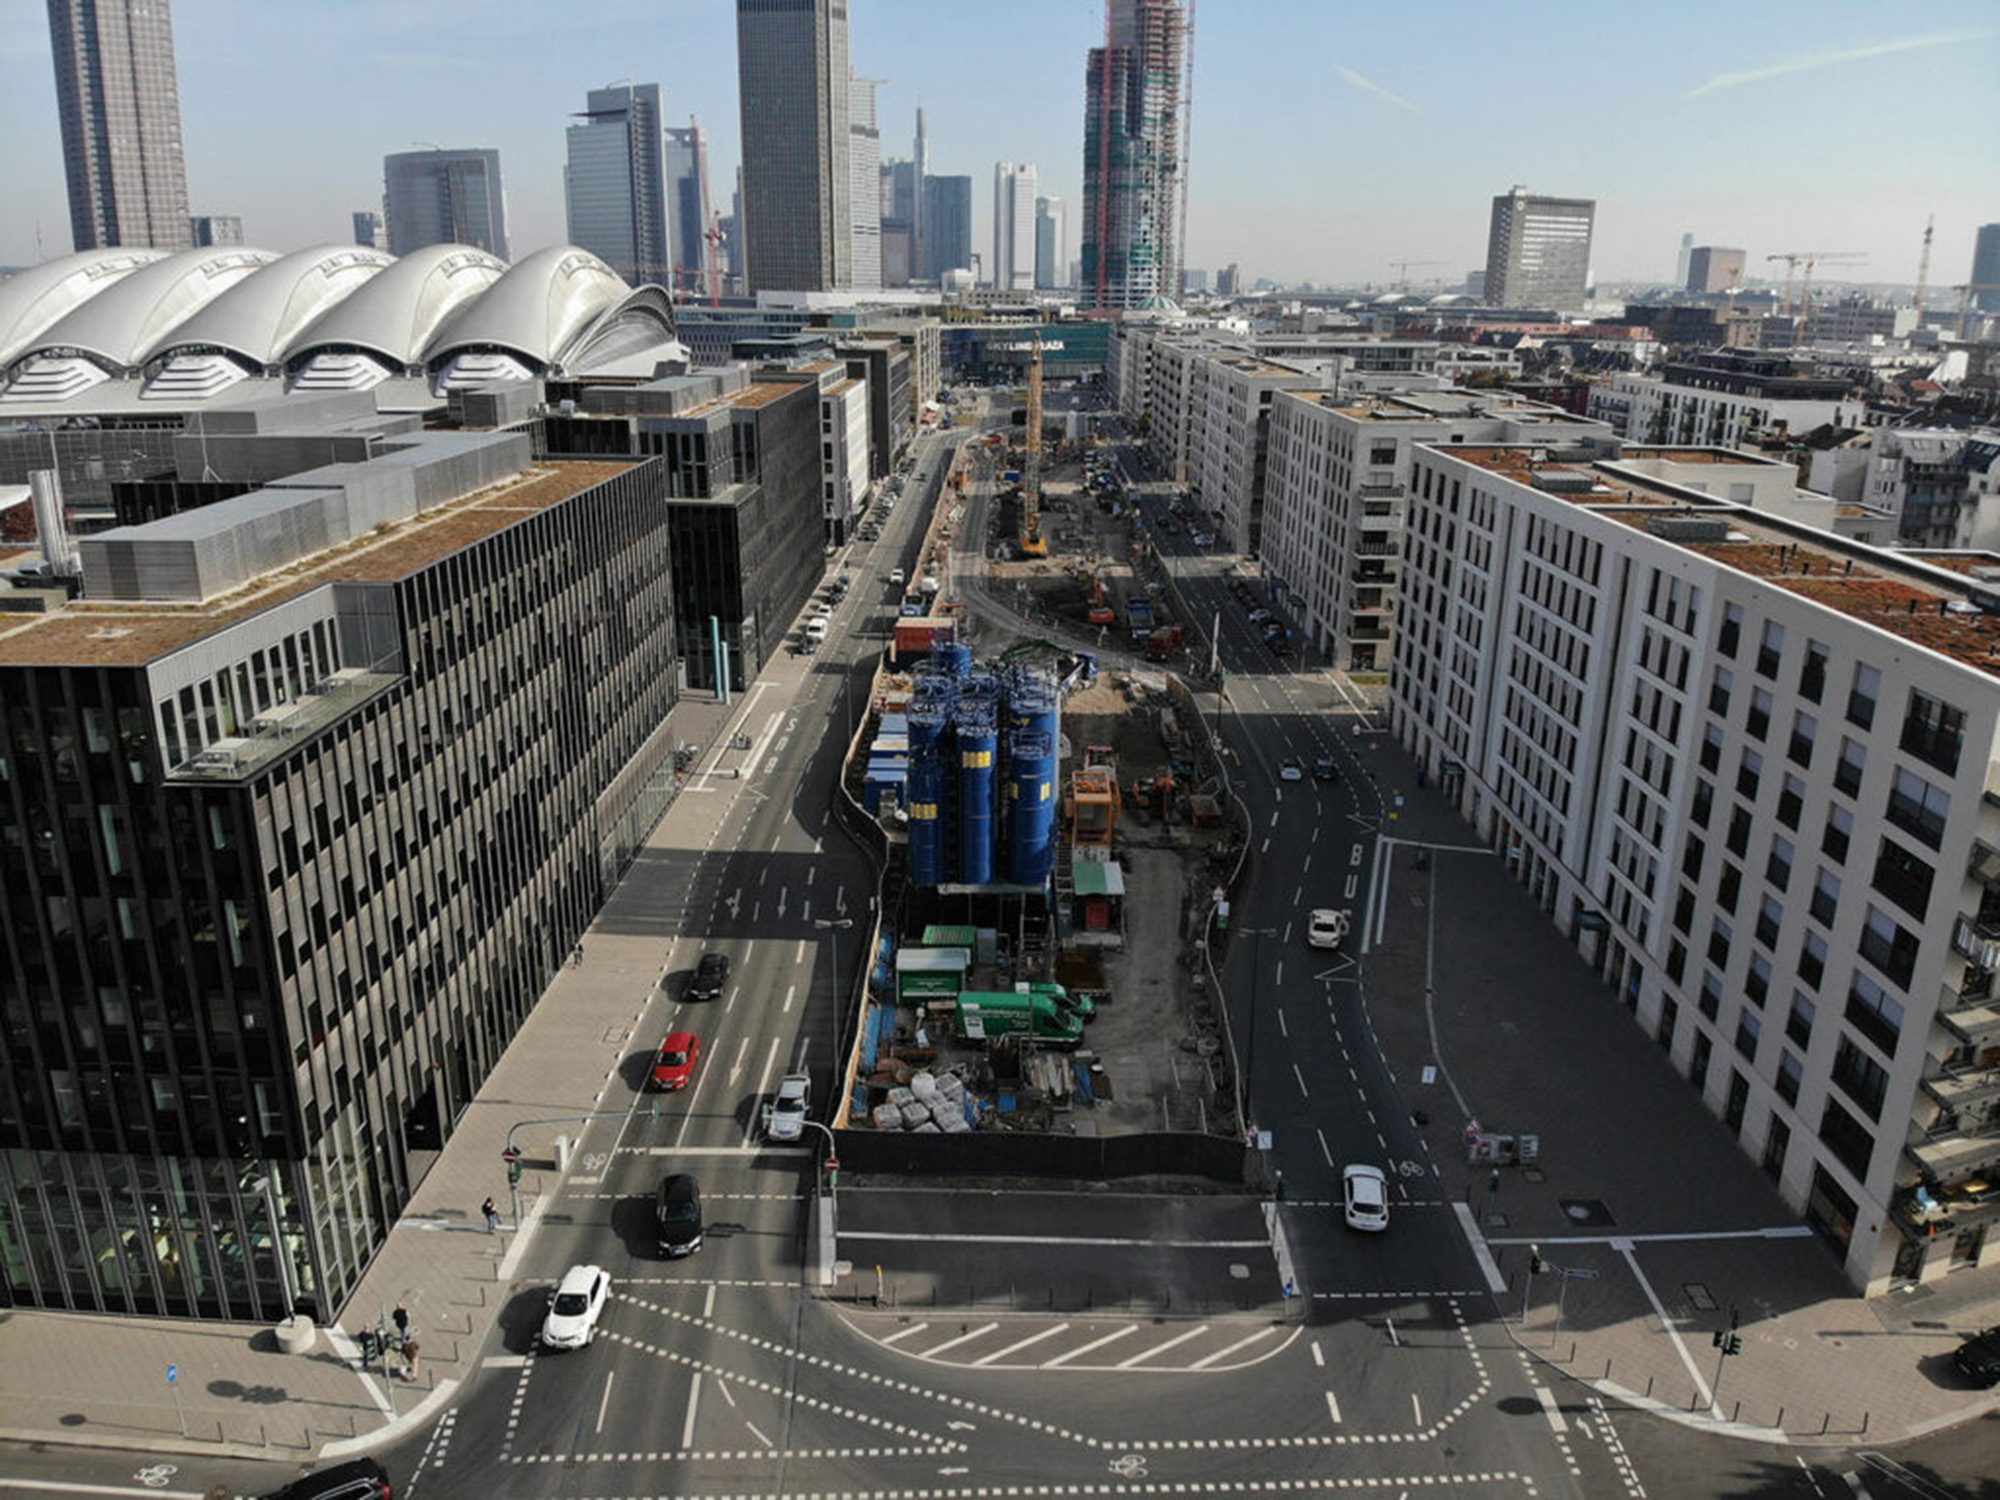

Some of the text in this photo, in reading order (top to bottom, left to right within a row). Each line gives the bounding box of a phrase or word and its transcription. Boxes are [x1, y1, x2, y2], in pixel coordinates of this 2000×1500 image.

[986, 340, 1065, 351] SKYLINE LAZA
[763, 717, 799, 774] BUS
